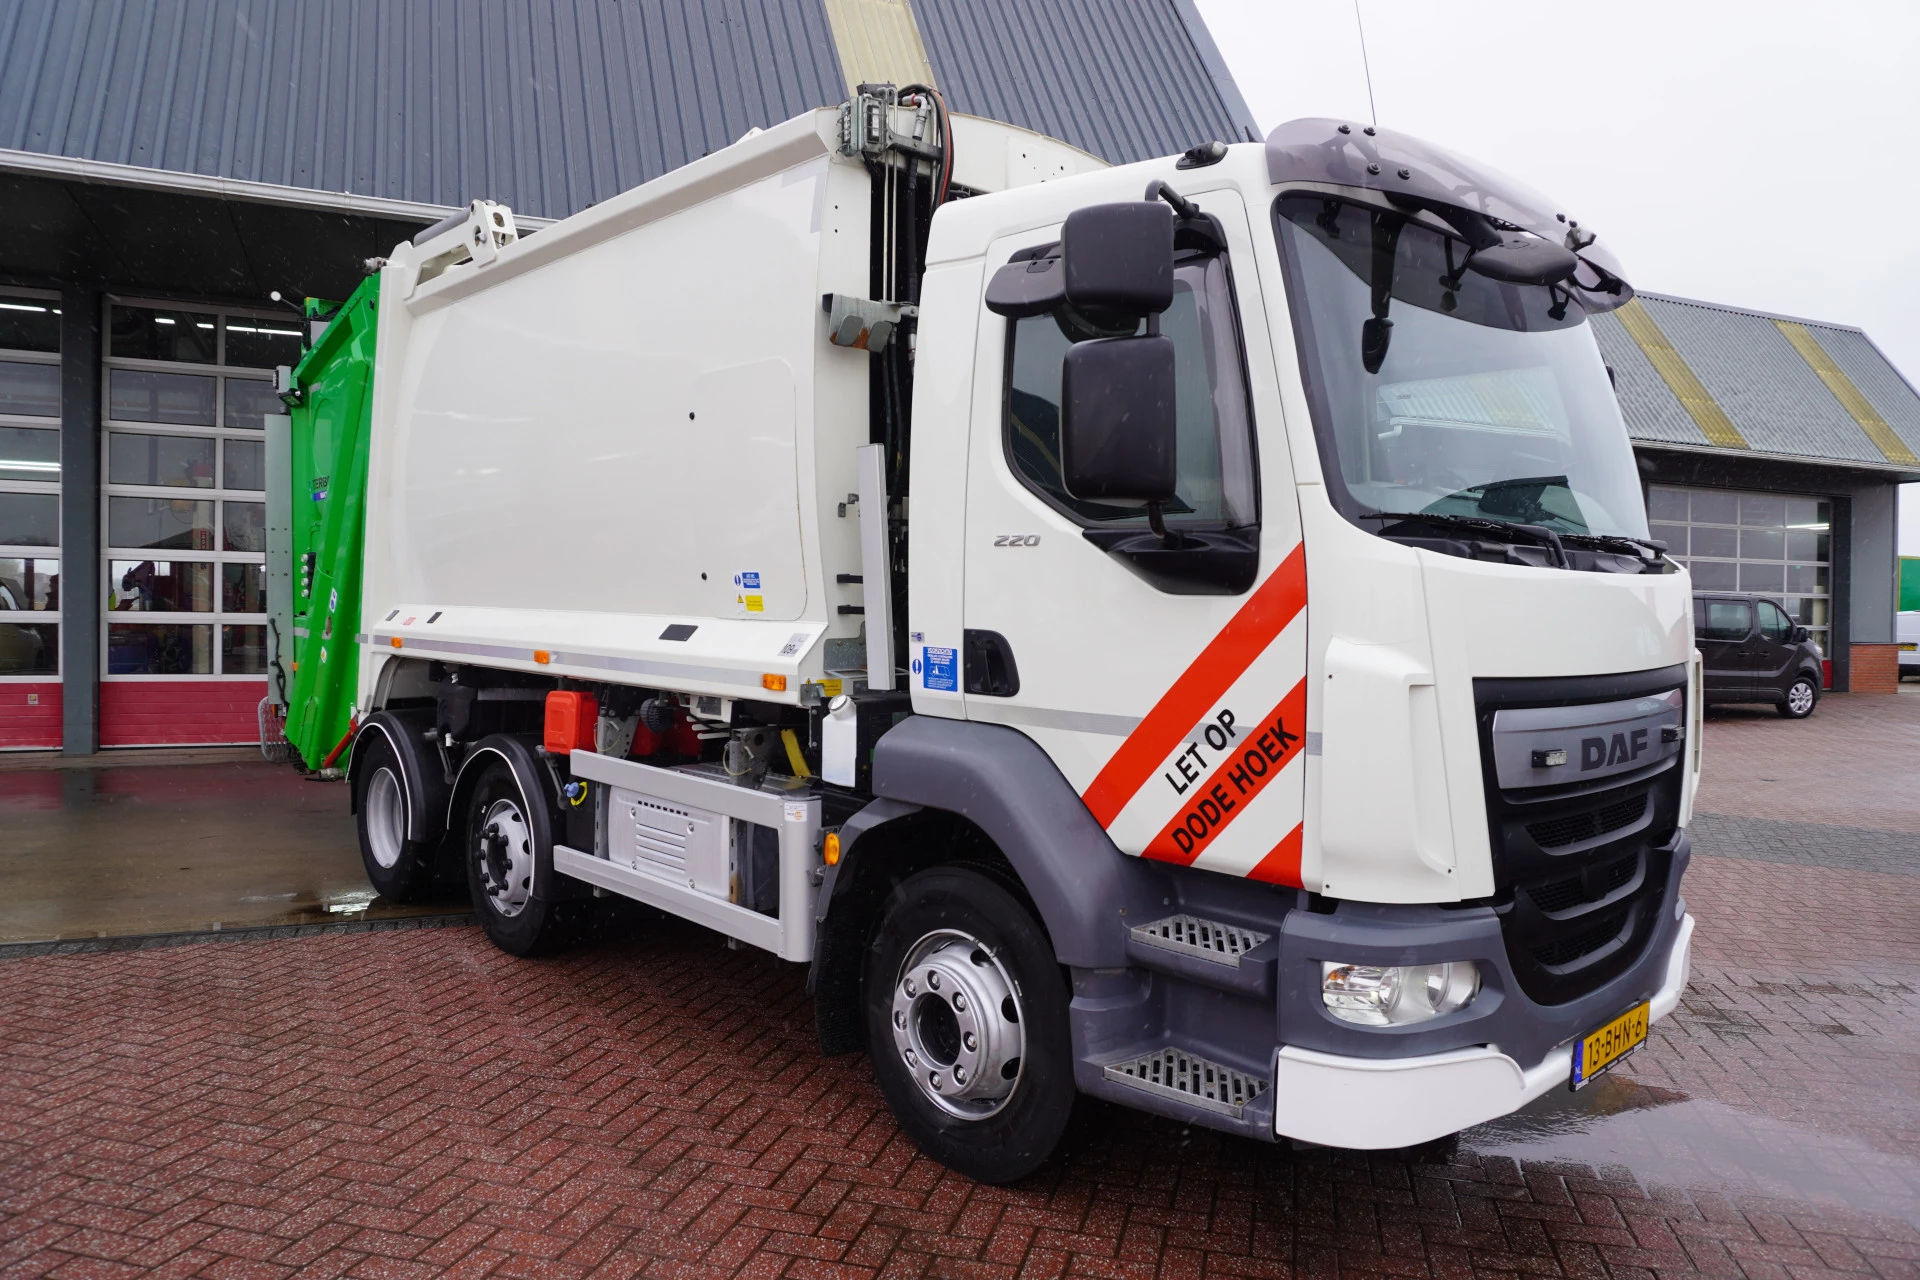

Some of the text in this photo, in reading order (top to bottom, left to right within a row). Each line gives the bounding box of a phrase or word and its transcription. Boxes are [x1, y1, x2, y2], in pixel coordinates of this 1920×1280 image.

[993, 534, 1041, 547] 220
[1165, 708, 1236, 795] LET OP
[1581, 728, 1648, 771] DAF
[1171, 716, 1299, 855] DODE HOEK
[1588, 1010, 1642, 1070] 13-BHN-6
